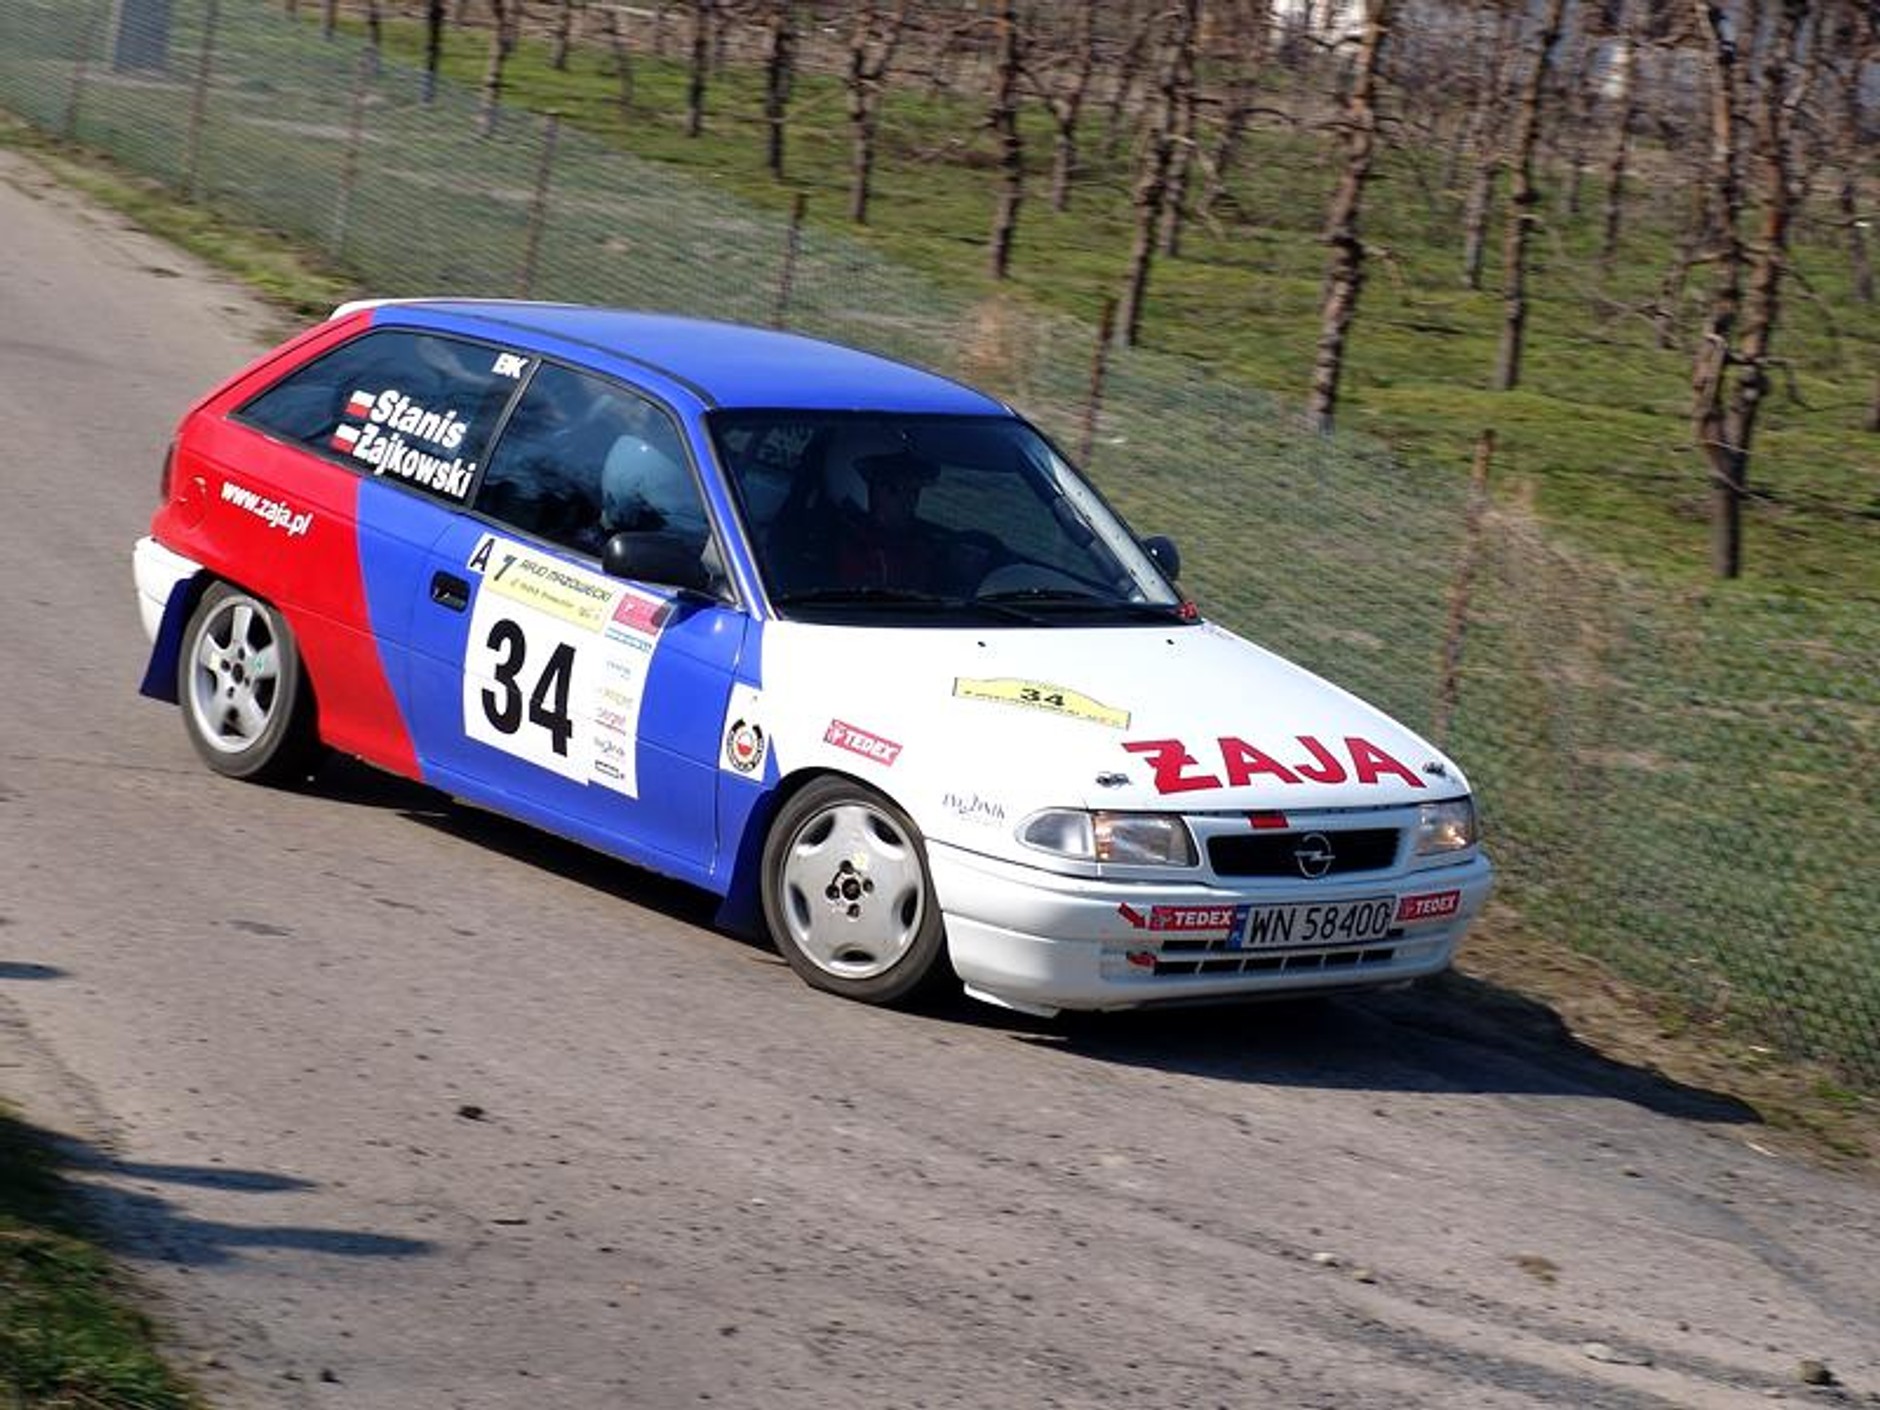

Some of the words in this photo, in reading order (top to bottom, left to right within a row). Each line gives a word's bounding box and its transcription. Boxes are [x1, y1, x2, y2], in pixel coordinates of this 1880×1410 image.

[369, 390, 467, 449] Stanis
[221, 482, 313, 536] www.zaja.pl
[469, 538, 495, 572] A
[481, 617, 578, 757] 34
[1019, 687, 1065, 707] 34
[843, 730, 898, 761] TEDEX
[1174, 910, 1232, 927] TEDEX
[1249, 907, 1296, 944] WN
[1301, 901, 1390, 941] 58400
